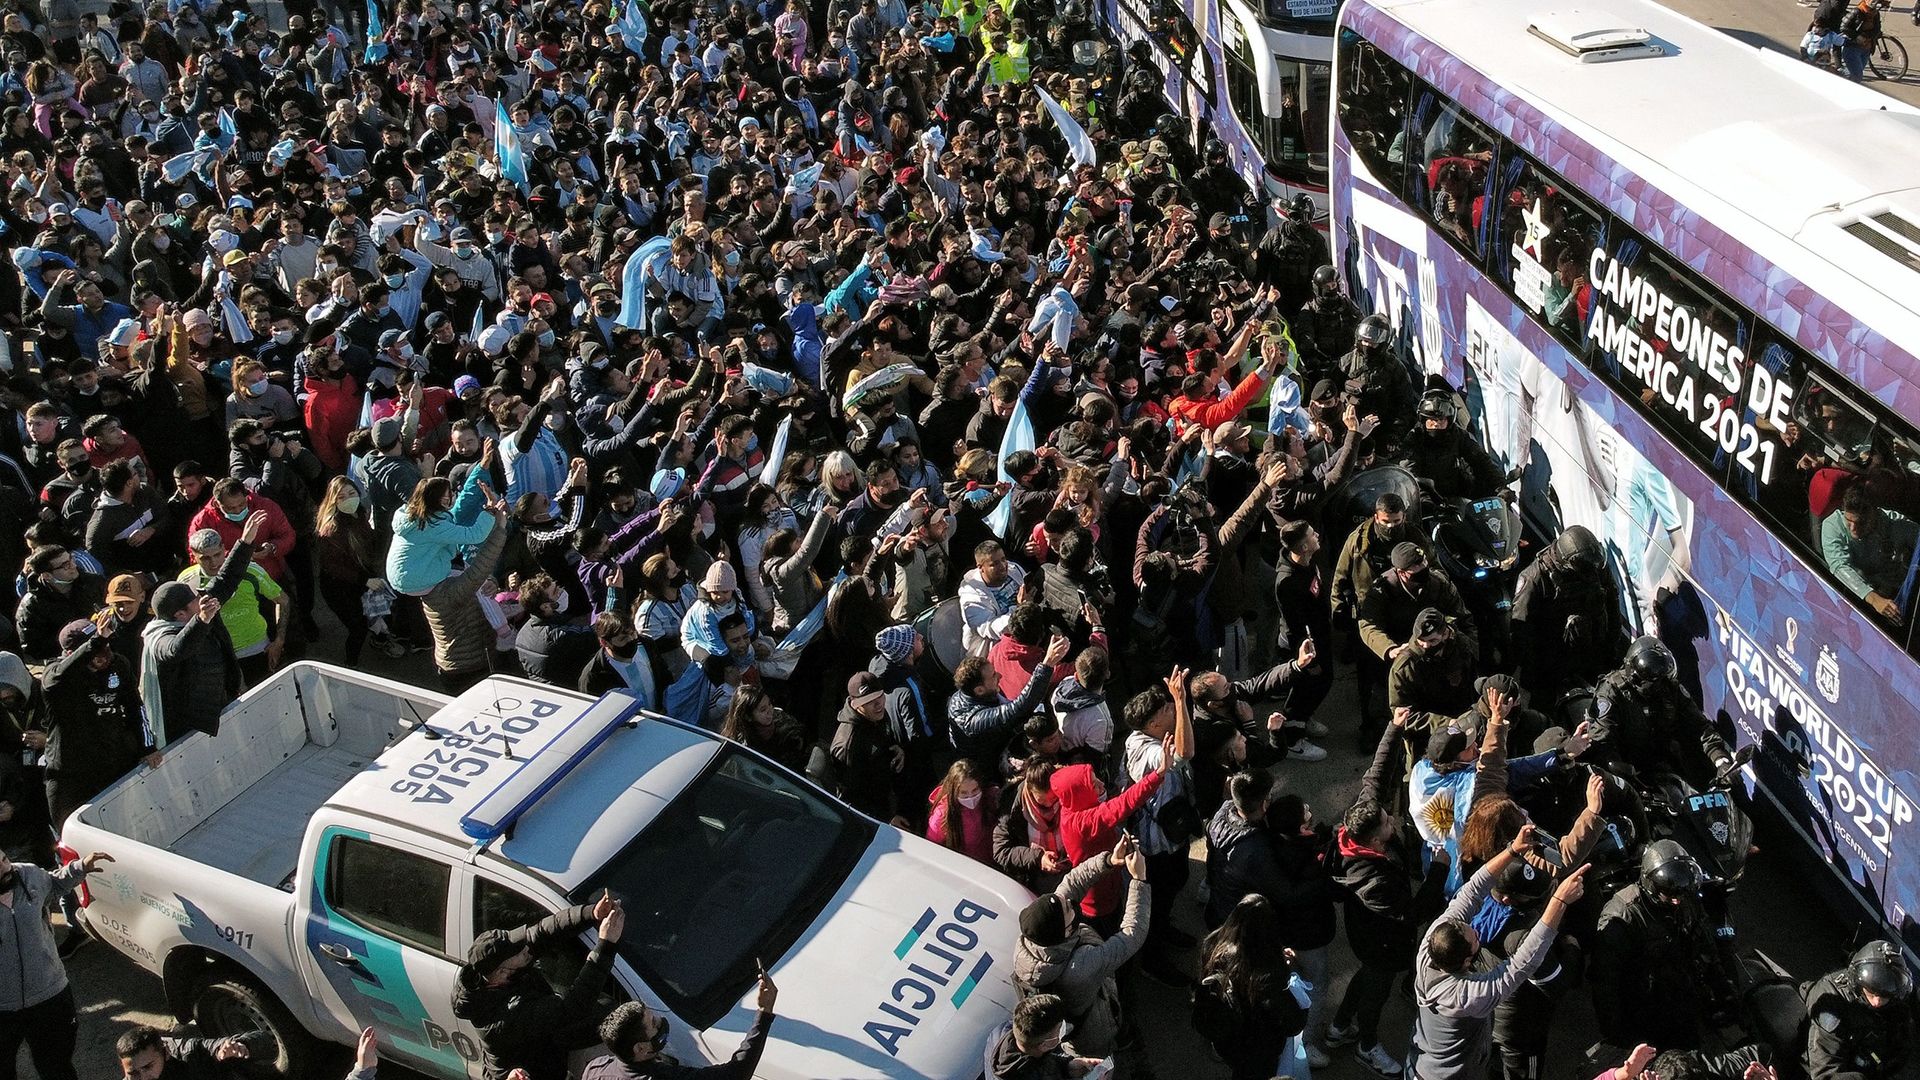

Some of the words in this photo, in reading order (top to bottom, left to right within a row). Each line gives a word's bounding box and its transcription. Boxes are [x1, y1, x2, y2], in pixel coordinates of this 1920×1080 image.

[1229, 214, 1249, 224] PFA
[1528, 221, 1540, 240] 15
[1589, 246, 1745, 394] CAMPEONES
[1747, 362, 1793, 433] DE
[1588, 303, 1695, 423] AMERICA
[1699, 392, 1775, 486] 2021
[1473, 498, 1503, 514] PFA
[1719, 626, 1765, 684] FIFA
[1767, 665, 1855, 773] WORLD
[1858, 761, 1914, 826] CUP
[412, 699, 563, 805] POLICIA
[1726, 660, 1813, 768] Qatar
[1813, 751, 1892, 858] 2022
[1689, 792, 1728, 812] PFA
[1831, 821, 1877, 873] RGENTINO
[140, 895, 171, 917] BUENOS
[101, 914, 132, 937] D.O.E.
[224, 925, 255, 950] 911
